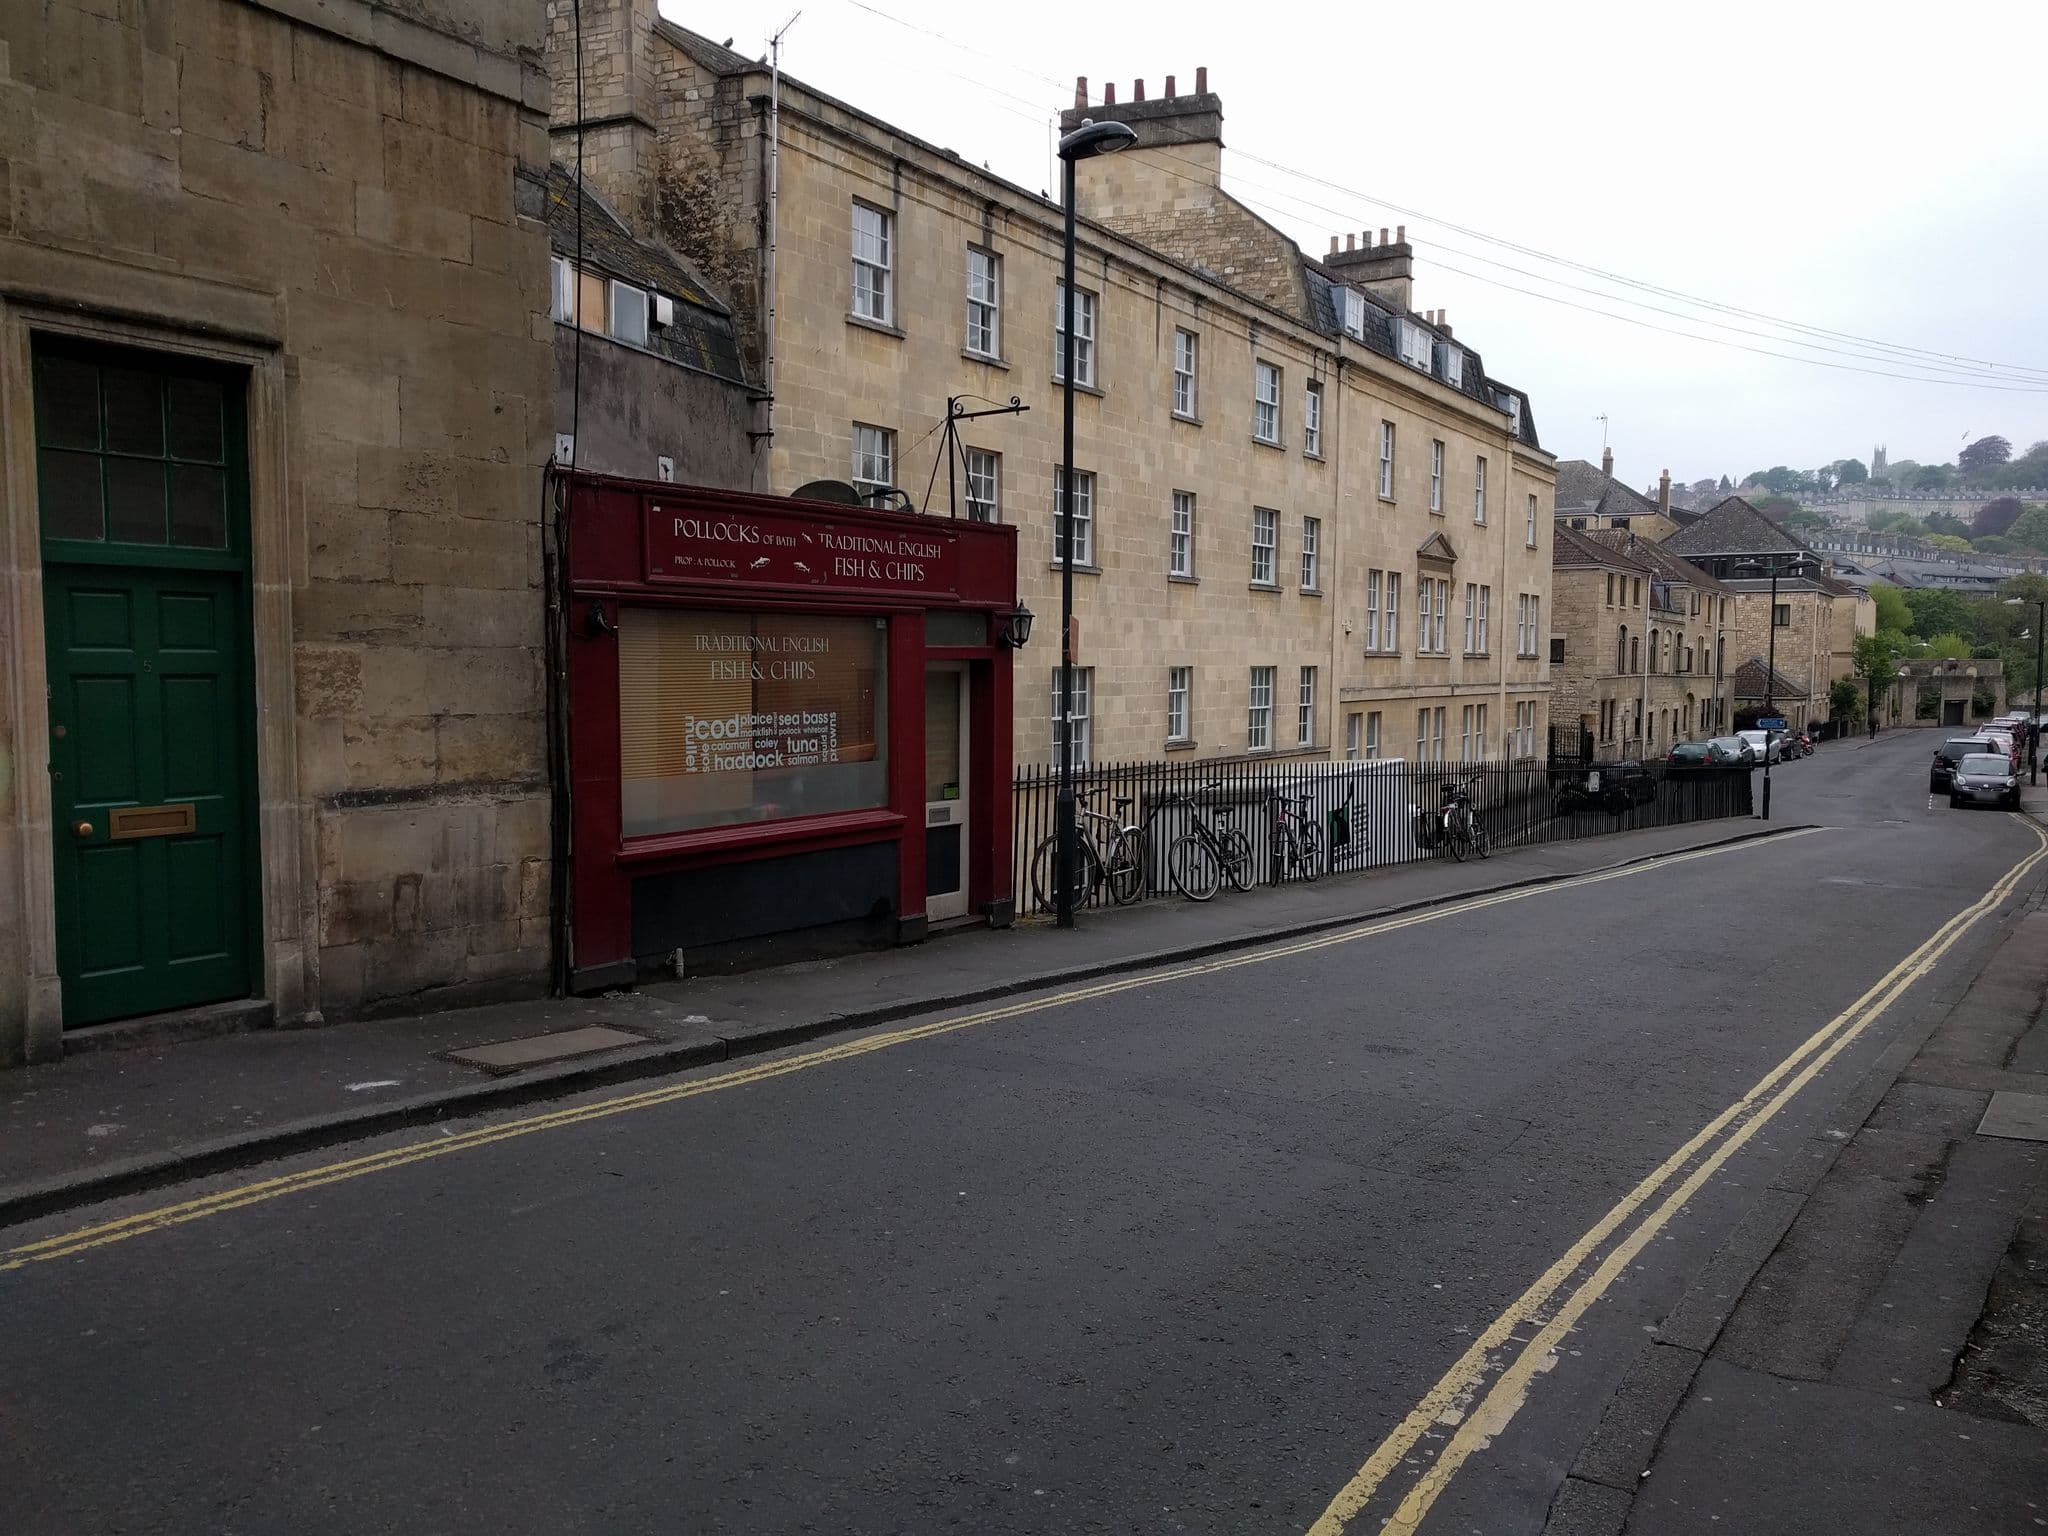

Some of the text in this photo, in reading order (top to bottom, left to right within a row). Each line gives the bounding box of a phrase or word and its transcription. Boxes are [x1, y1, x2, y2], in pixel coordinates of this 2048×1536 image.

[674, 518, 796, 547] POLLOCKS OF BATH
[818, 532, 941, 559] TRADITIONAL ENGLISH
[704, 558, 736, 568] POLLOCK
[835, 557, 925, 582] FISH & CHIPS
[693, 634, 829, 653] TRADITIONAL ENGLISH
[711, 660, 816, 680] FISH & CHIPS
[695, 713, 739, 740] cod
[740, 712, 773, 729] plaice
[779, 711, 829, 726] sea bass
[740, 727, 773, 737] monkfish
[779, 726, 801, 737] pollock
[830, 711, 839, 763] prawns
[685, 715, 697, 773] mullet
[711, 740, 749, 752] calamari
[755, 738, 779, 750] coley
[787, 737, 818, 753] tuna
[821, 735, 829, 763] squid
[702, 743, 710, 773] sole
[714, 750, 784, 771] haddock
[788, 754, 819, 767] salmon
